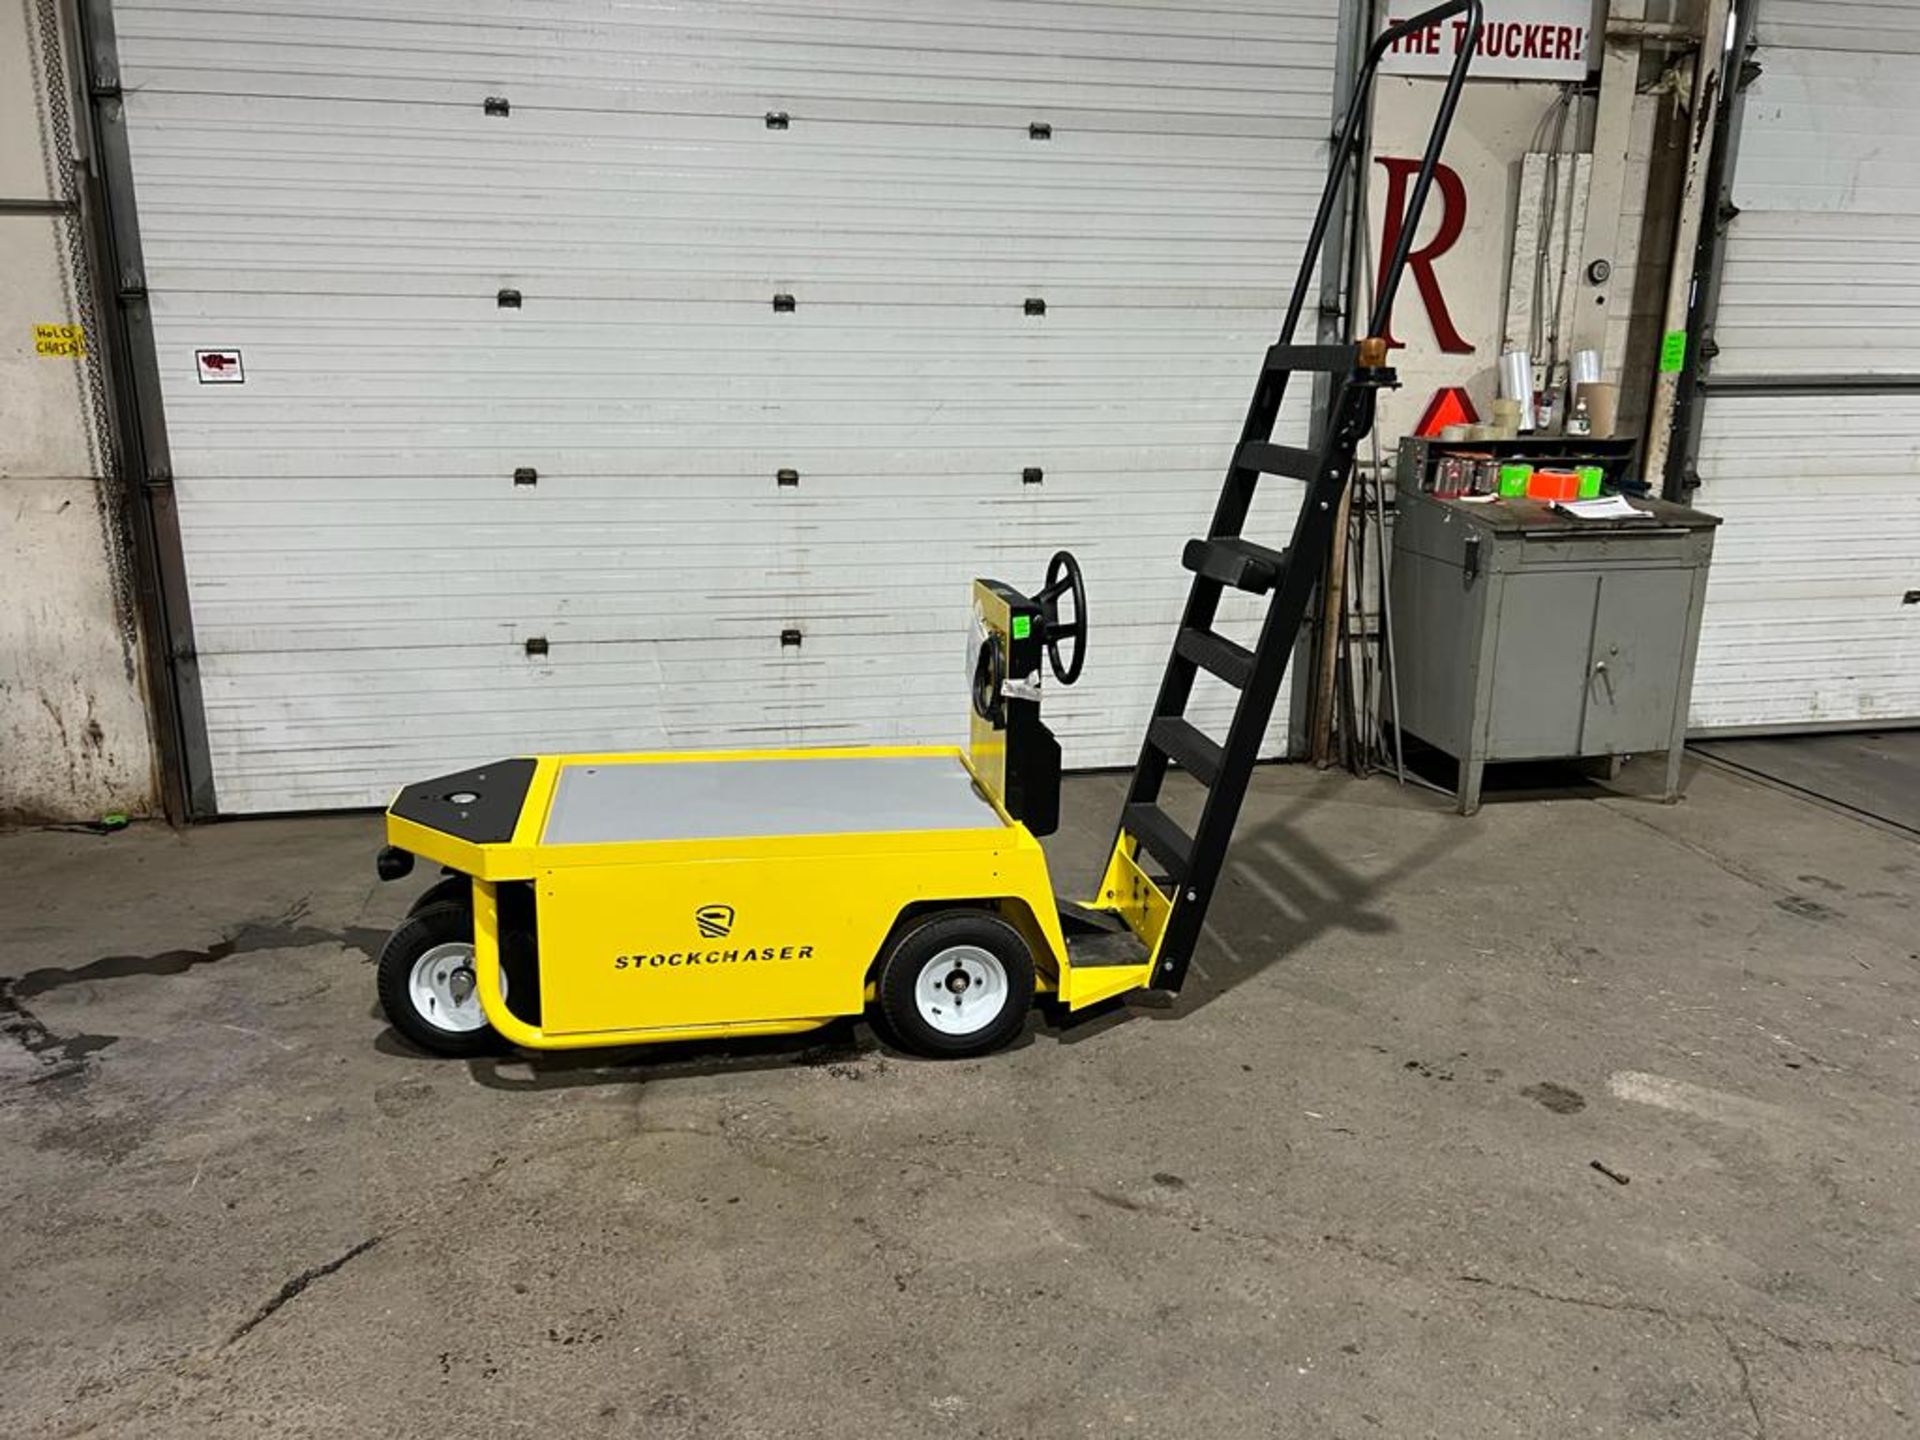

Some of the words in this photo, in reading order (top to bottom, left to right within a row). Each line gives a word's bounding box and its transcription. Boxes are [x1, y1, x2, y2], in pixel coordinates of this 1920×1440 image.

[1388, 18, 1441, 55] THE
[1452, 21, 1583, 61] TRUCKER!
[1355, 156, 1476, 354] R
[614, 945, 815, 970] STOCKCHASER
